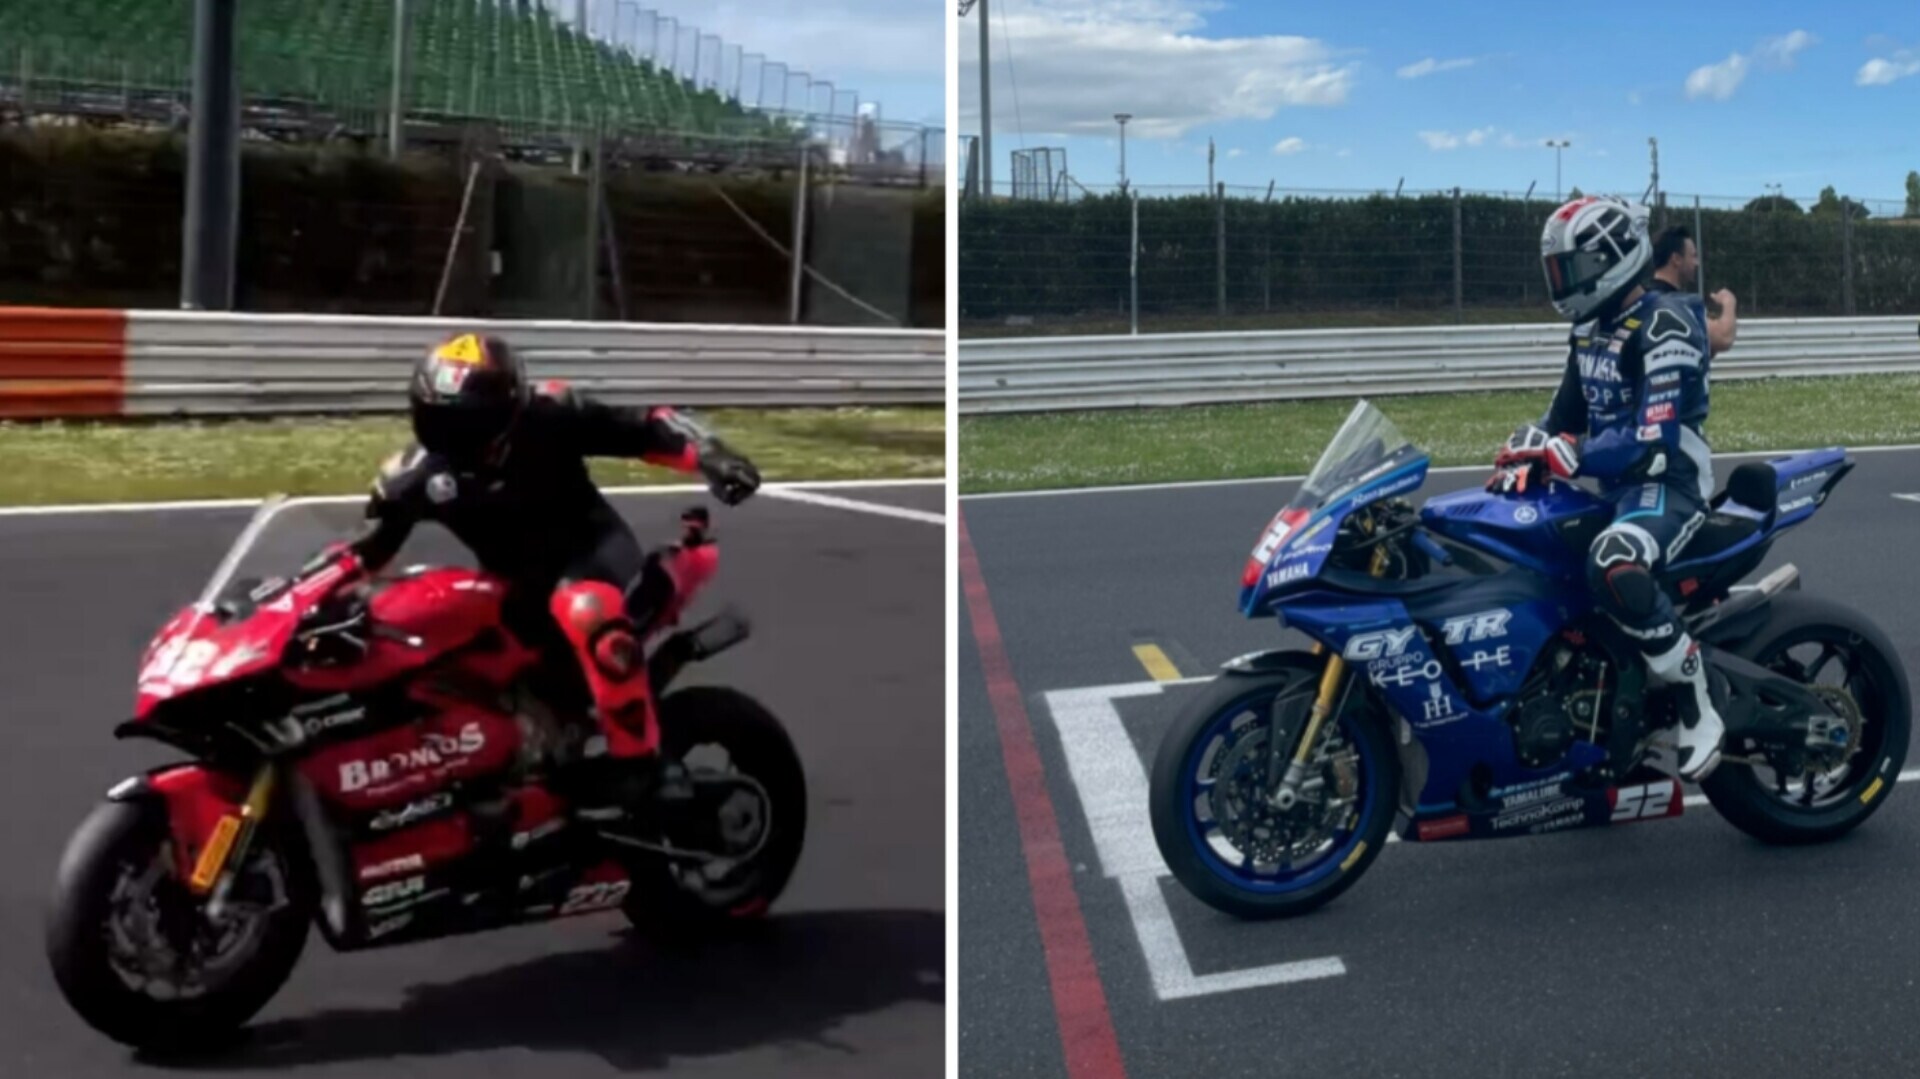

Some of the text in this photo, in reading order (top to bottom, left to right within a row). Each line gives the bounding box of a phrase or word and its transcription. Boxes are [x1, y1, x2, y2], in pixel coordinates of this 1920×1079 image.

[1267, 562, 1310, 588] YAMAHA
[1368, 651, 1424, 672] GRUPPO
[1502, 784, 1562, 809] YAMALUBE
[1610, 779, 1674, 821] 52
